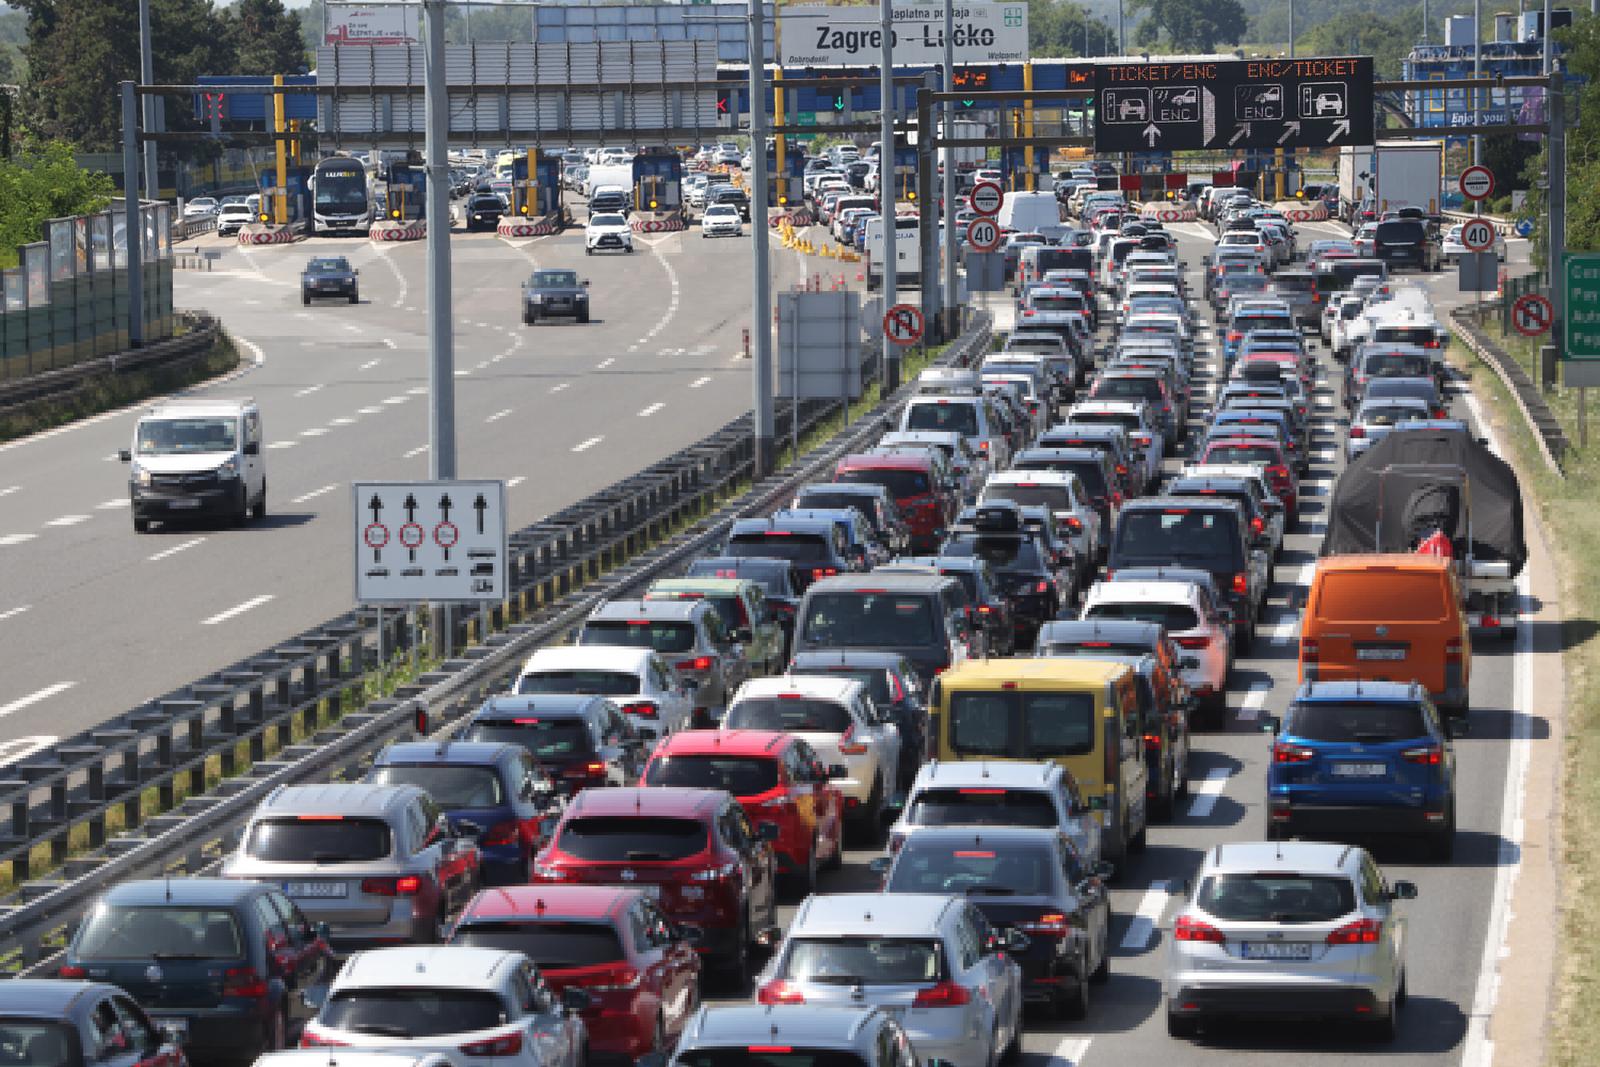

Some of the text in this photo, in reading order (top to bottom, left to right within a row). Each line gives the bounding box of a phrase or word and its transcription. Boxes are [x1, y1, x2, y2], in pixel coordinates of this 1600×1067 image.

[987, 51, 1022, 60] Welcome!
[1107, 64, 1217, 81] TICKET/ENC
[1247, 60, 1358, 78] ENC/TICKET
[1161, 108, 1191, 121] ENC
[1244, 106, 1275, 119] ENC
[974, 226, 994, 243] 40
[1468, 227, 1488, 244] 40
